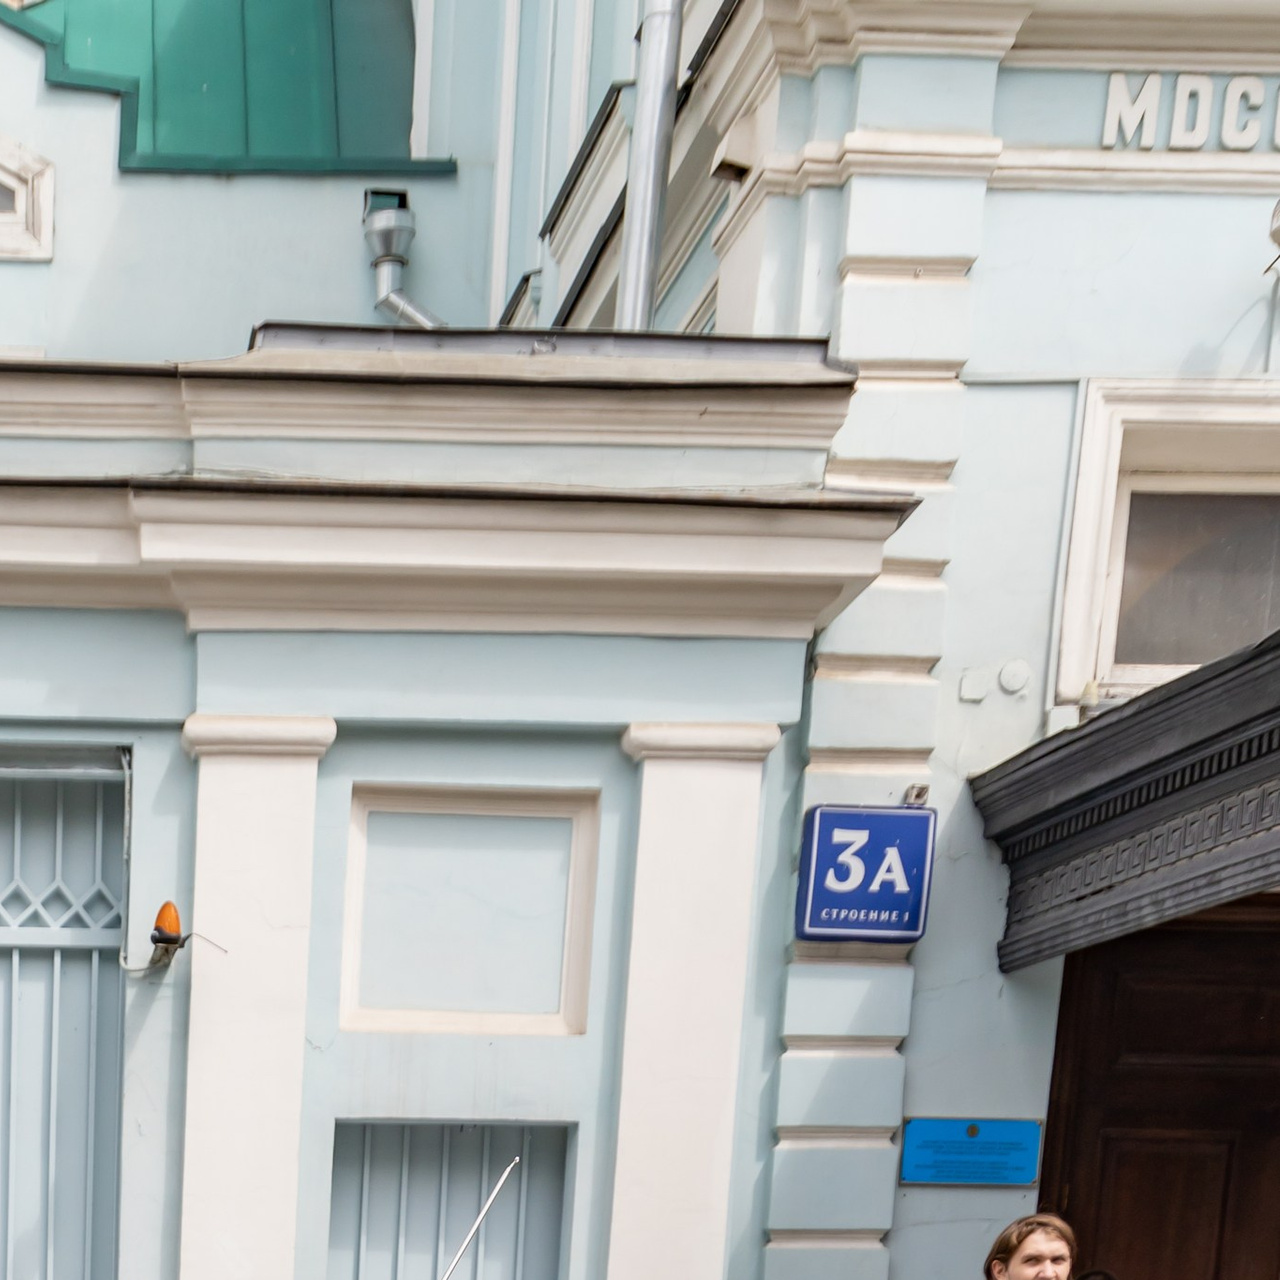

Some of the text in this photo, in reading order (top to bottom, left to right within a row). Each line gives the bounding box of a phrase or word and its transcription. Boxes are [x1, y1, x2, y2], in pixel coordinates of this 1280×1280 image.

[1101, 71, 1280, 151] MDC
[824, 827, 911, 894] 3А
[821, 907, 910, 923] СТРОЕНИЕ 1
